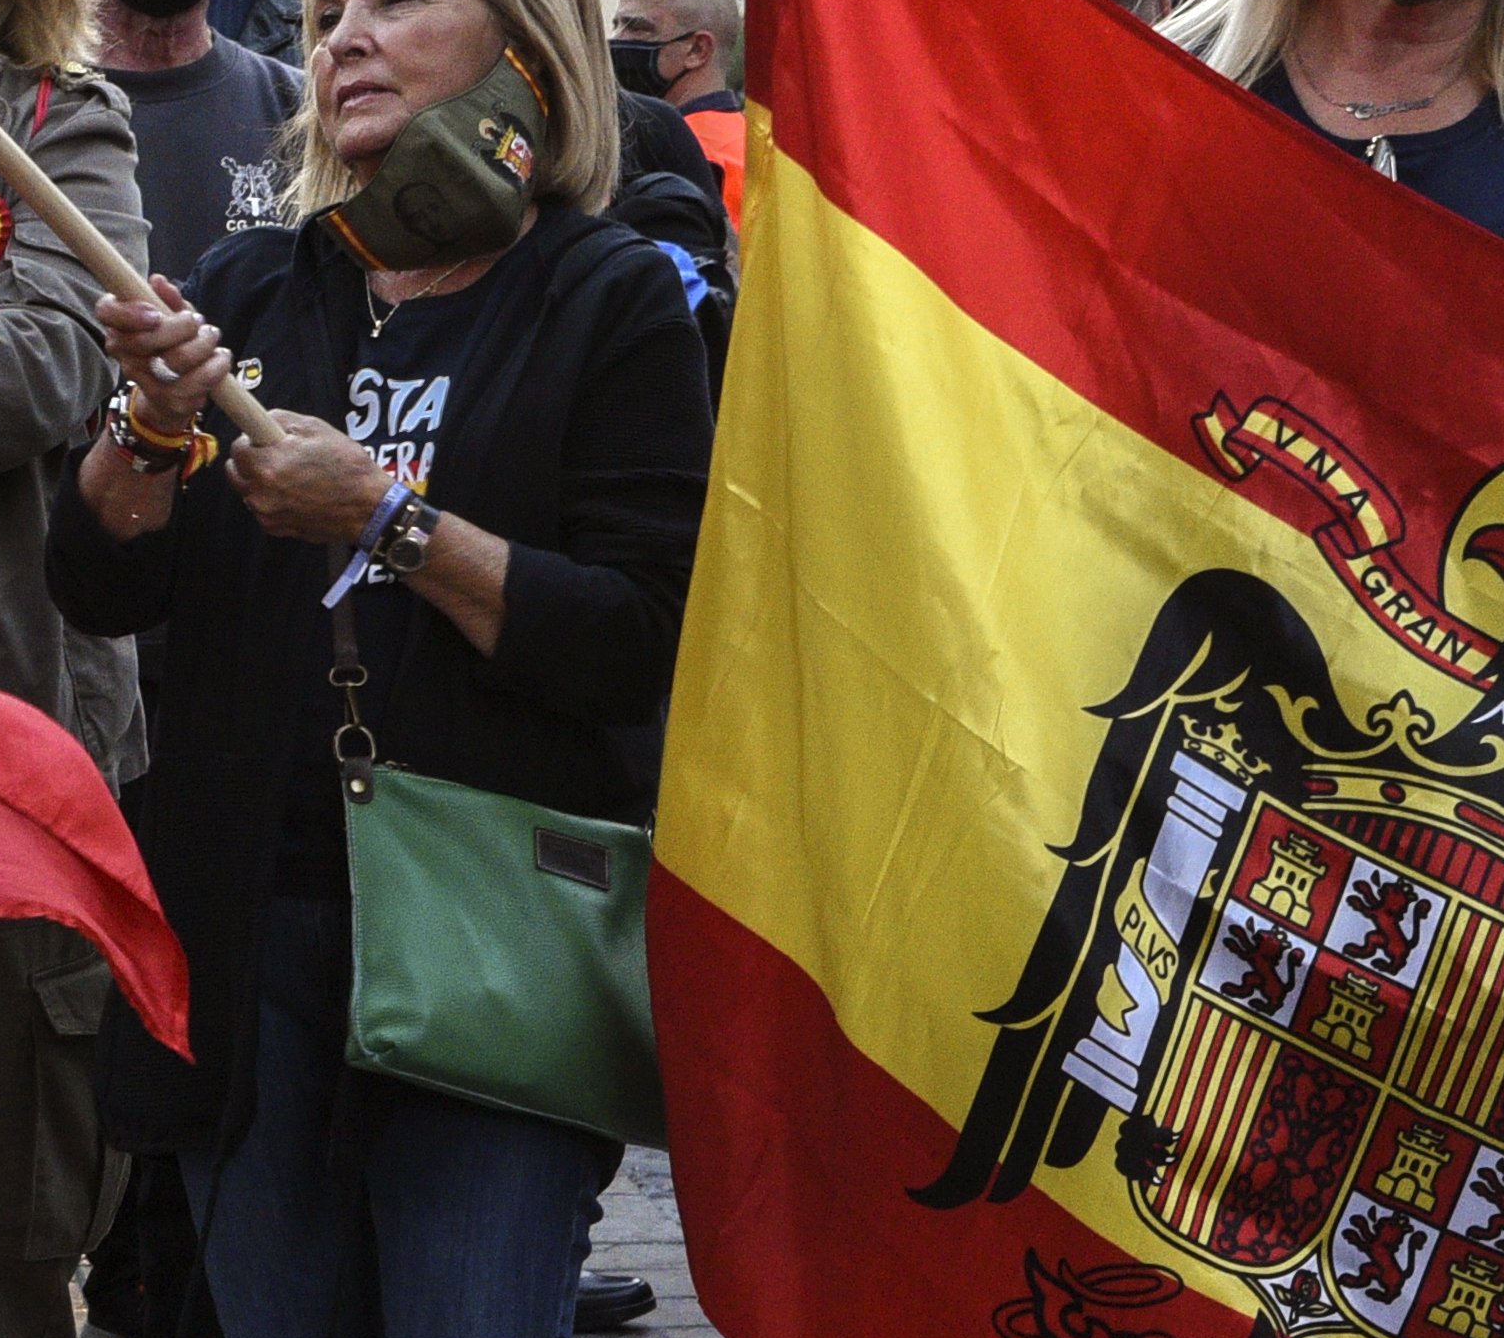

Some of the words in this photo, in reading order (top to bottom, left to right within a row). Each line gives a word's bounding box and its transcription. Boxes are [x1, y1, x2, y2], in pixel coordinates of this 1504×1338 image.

[1273, 417, 1371, 520] VNA
[1360, 563, 1473, 668] GRAN
[1119, 901, 1177, 981] PLVS
